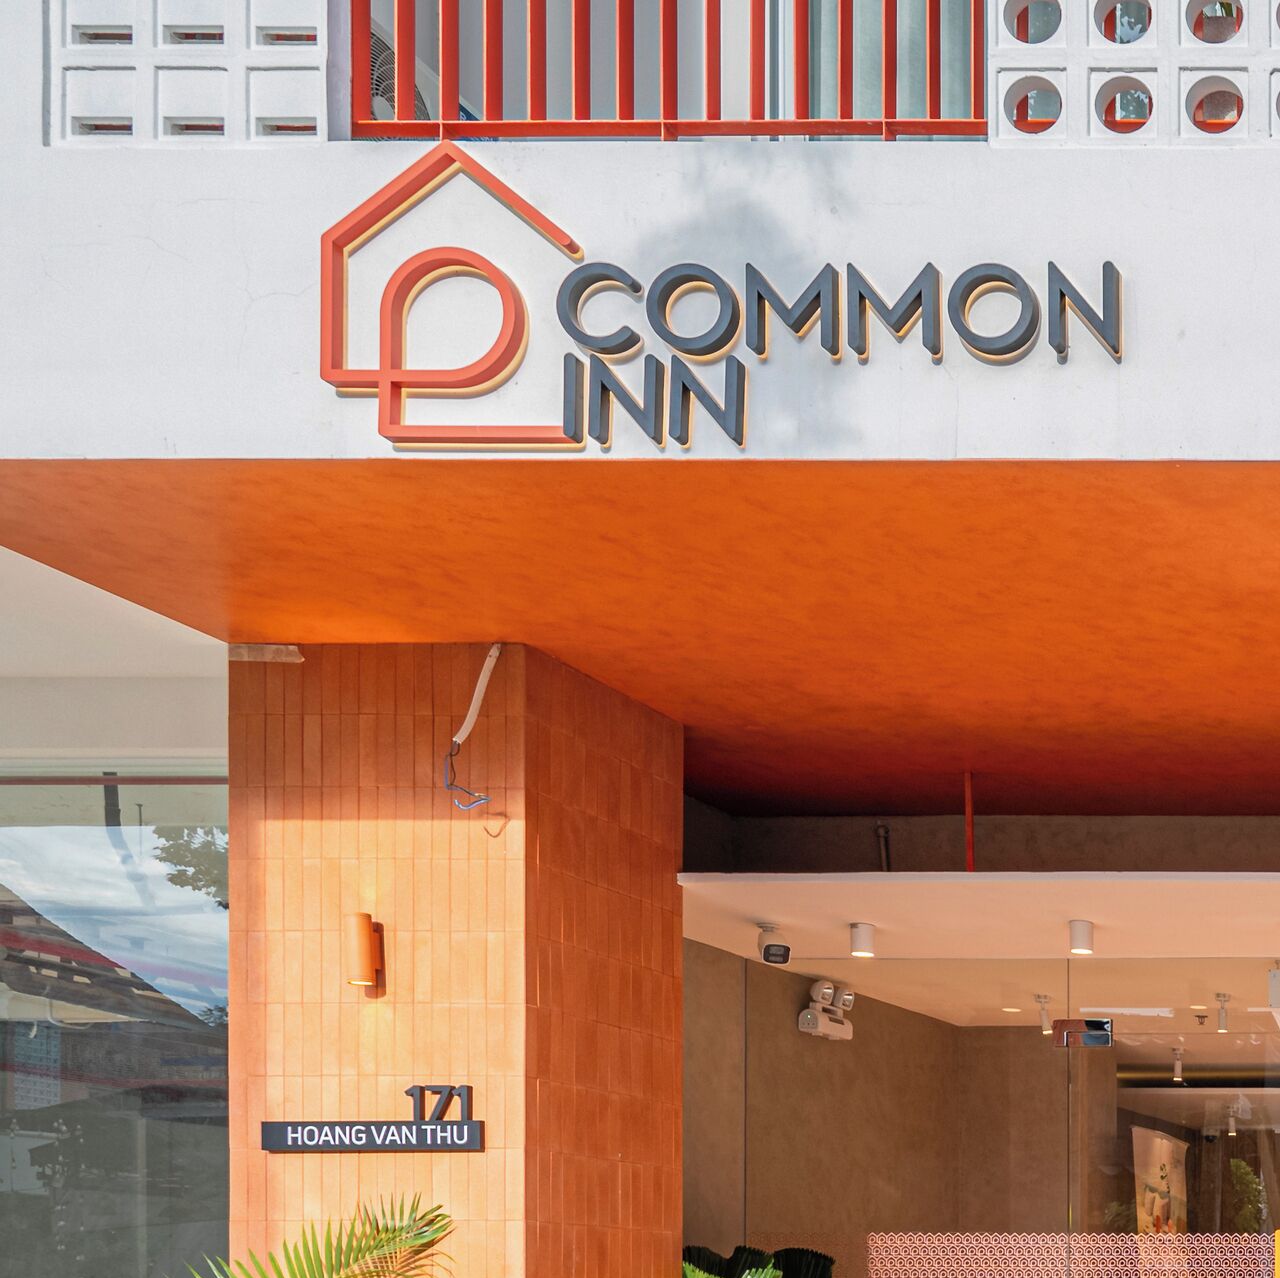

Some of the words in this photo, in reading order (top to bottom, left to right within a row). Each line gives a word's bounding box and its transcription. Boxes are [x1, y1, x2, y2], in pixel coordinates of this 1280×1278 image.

[556, 260, 1123, 362] COMMON
[563, 352, 748, 449] INN
[286, 1125, 367, 1146] HOANG
[370, 1125, 418, 1146] VAN
[421, 1125, 469, 1146] THU
[404, 1084, 474, 1121] 171
